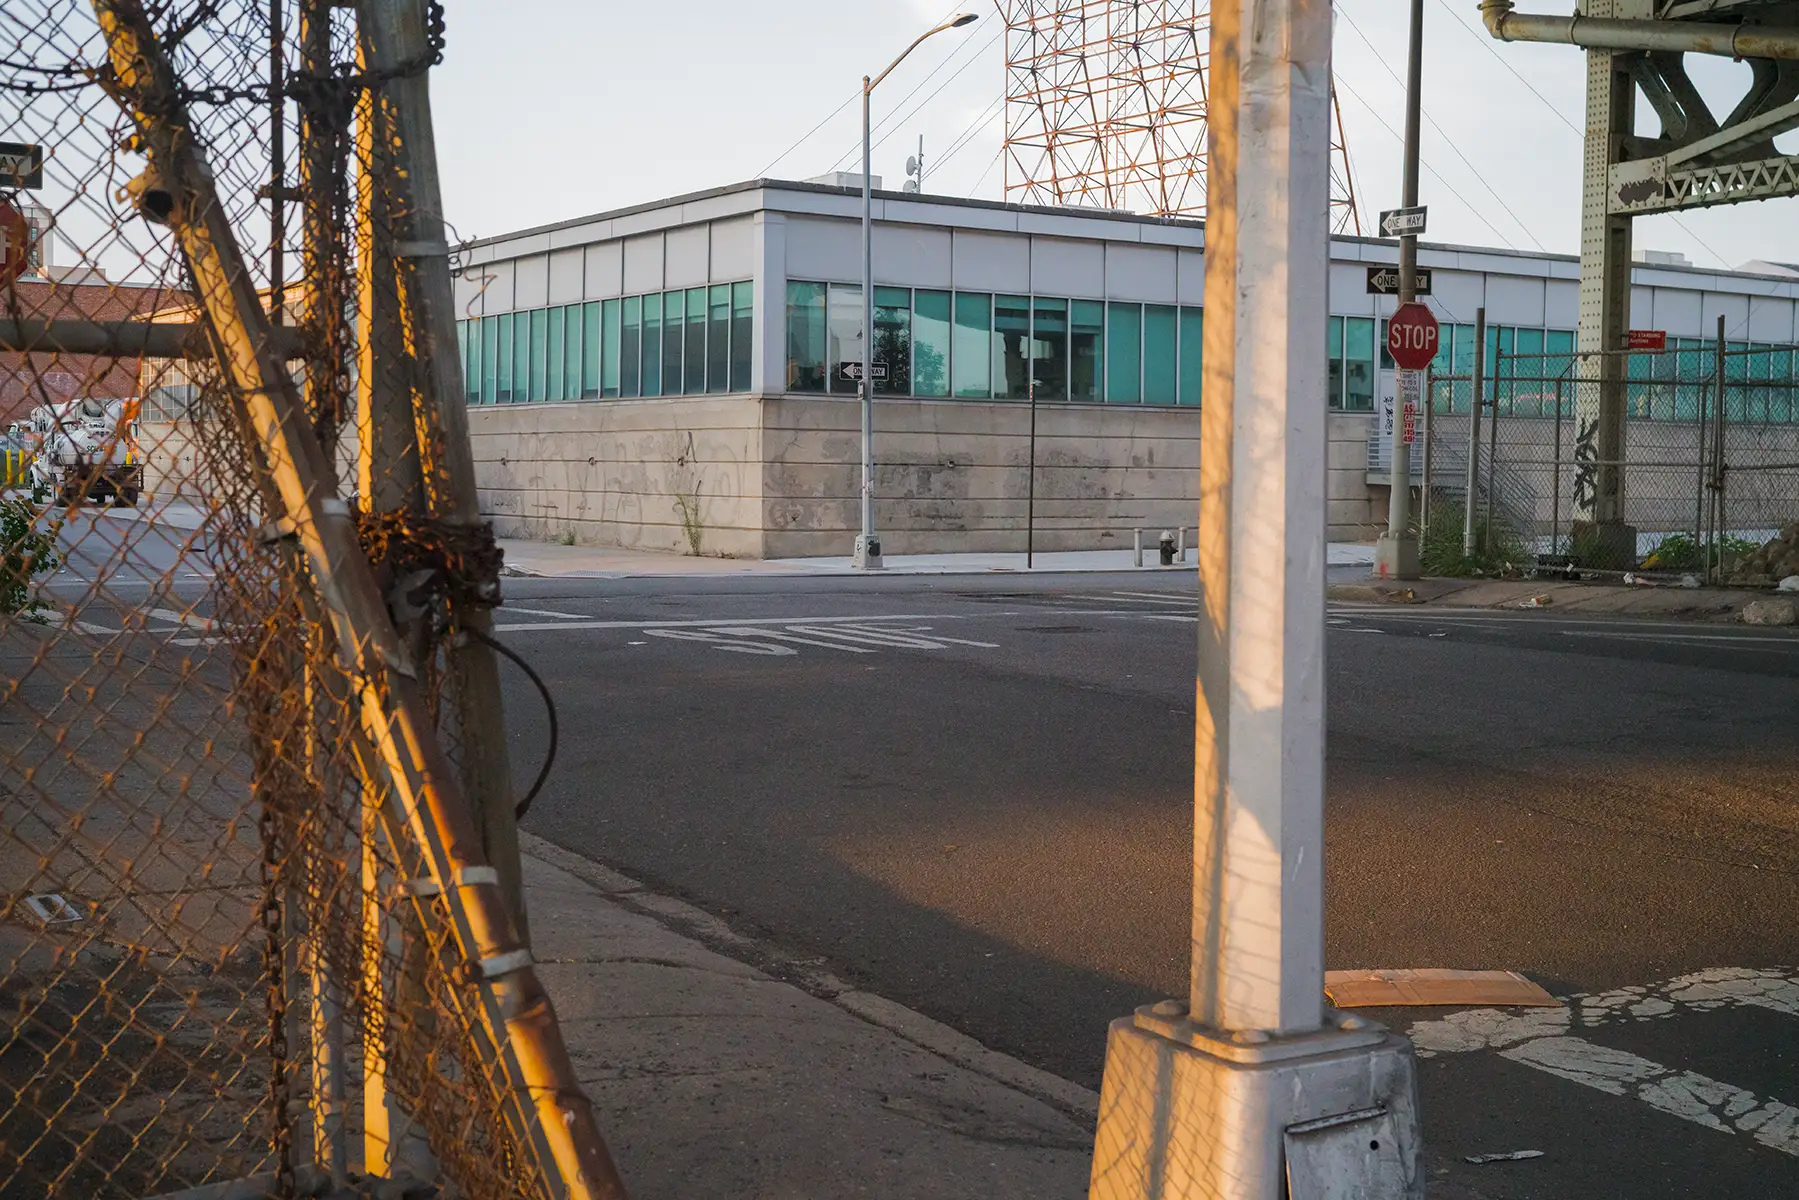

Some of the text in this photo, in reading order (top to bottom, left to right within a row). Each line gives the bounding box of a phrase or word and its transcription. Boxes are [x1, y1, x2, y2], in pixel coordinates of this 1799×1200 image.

[1387, 214, 1422, 229] ONE WAY
[1377, 275, 1396, 287] ONE
[1391, 323, 1436, 350] STOP
[643, 623, 1000, 656] STOP
